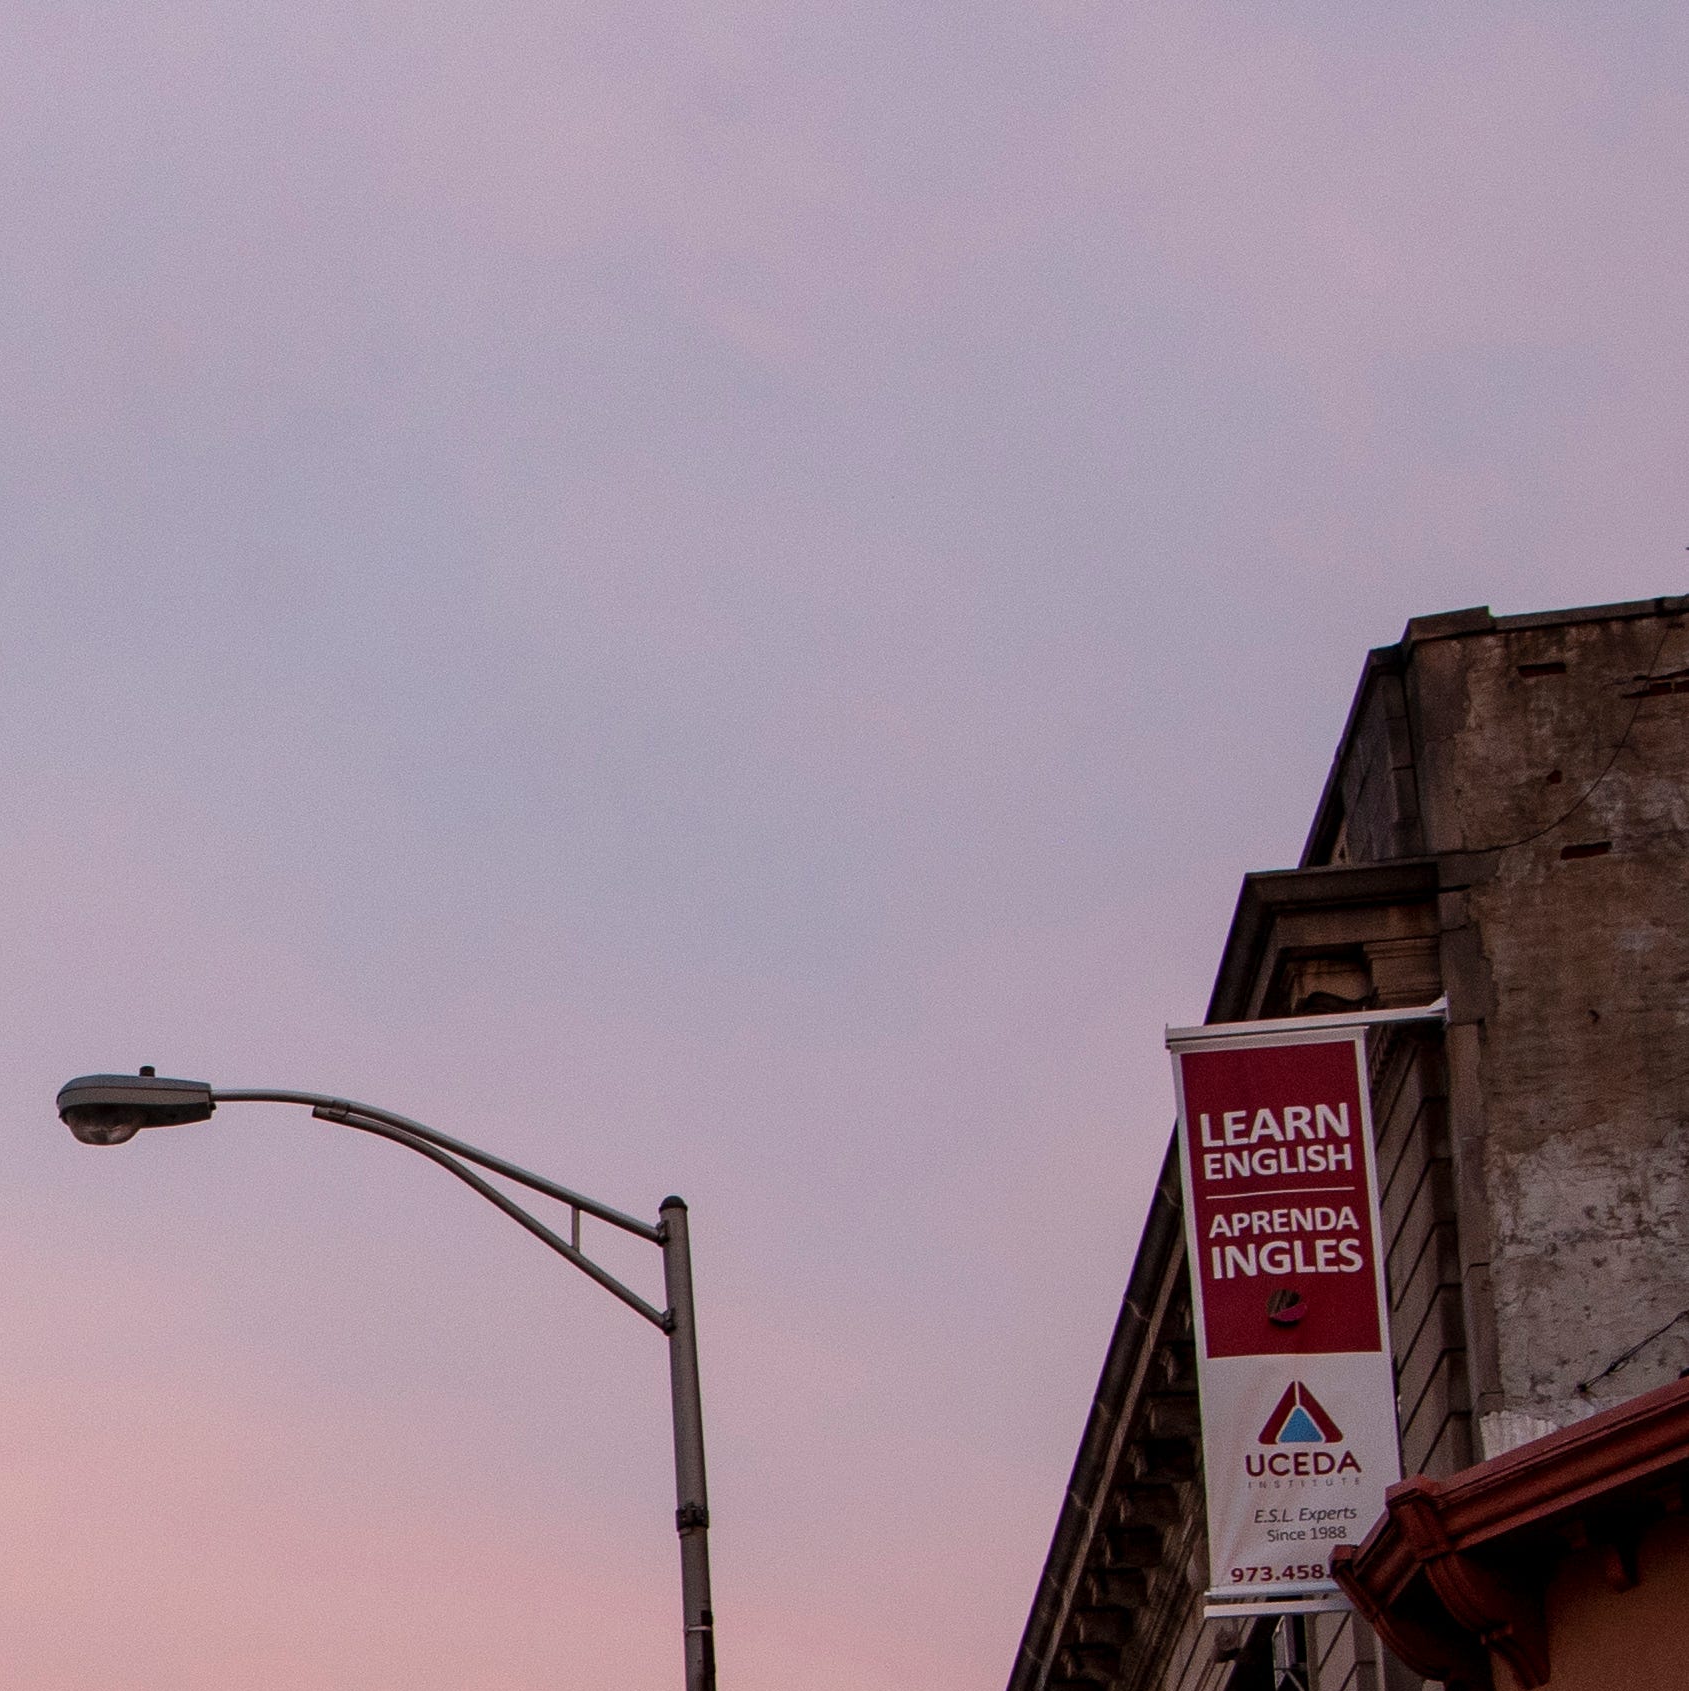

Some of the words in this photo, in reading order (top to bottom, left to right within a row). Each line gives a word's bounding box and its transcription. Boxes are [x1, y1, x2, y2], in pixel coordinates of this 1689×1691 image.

[1200, 1102, 1351, 1149] LEARN
[1203, 1143, 1353, 1181] ENGLISH
[1209, 1205, 1360, 1240] APRENDA
[1211, 1238, 1364, 1280] INGLES
[1245, 1450, 1362, 1477] UCEDA
[1247, 1477, 1360, 1489] INSTITUTE
[1298, 1507, 1357, 1523] Experts
[1267, 1528, 1307, 1543] Since
[1310, 1525, 1347, 1541] 1988
